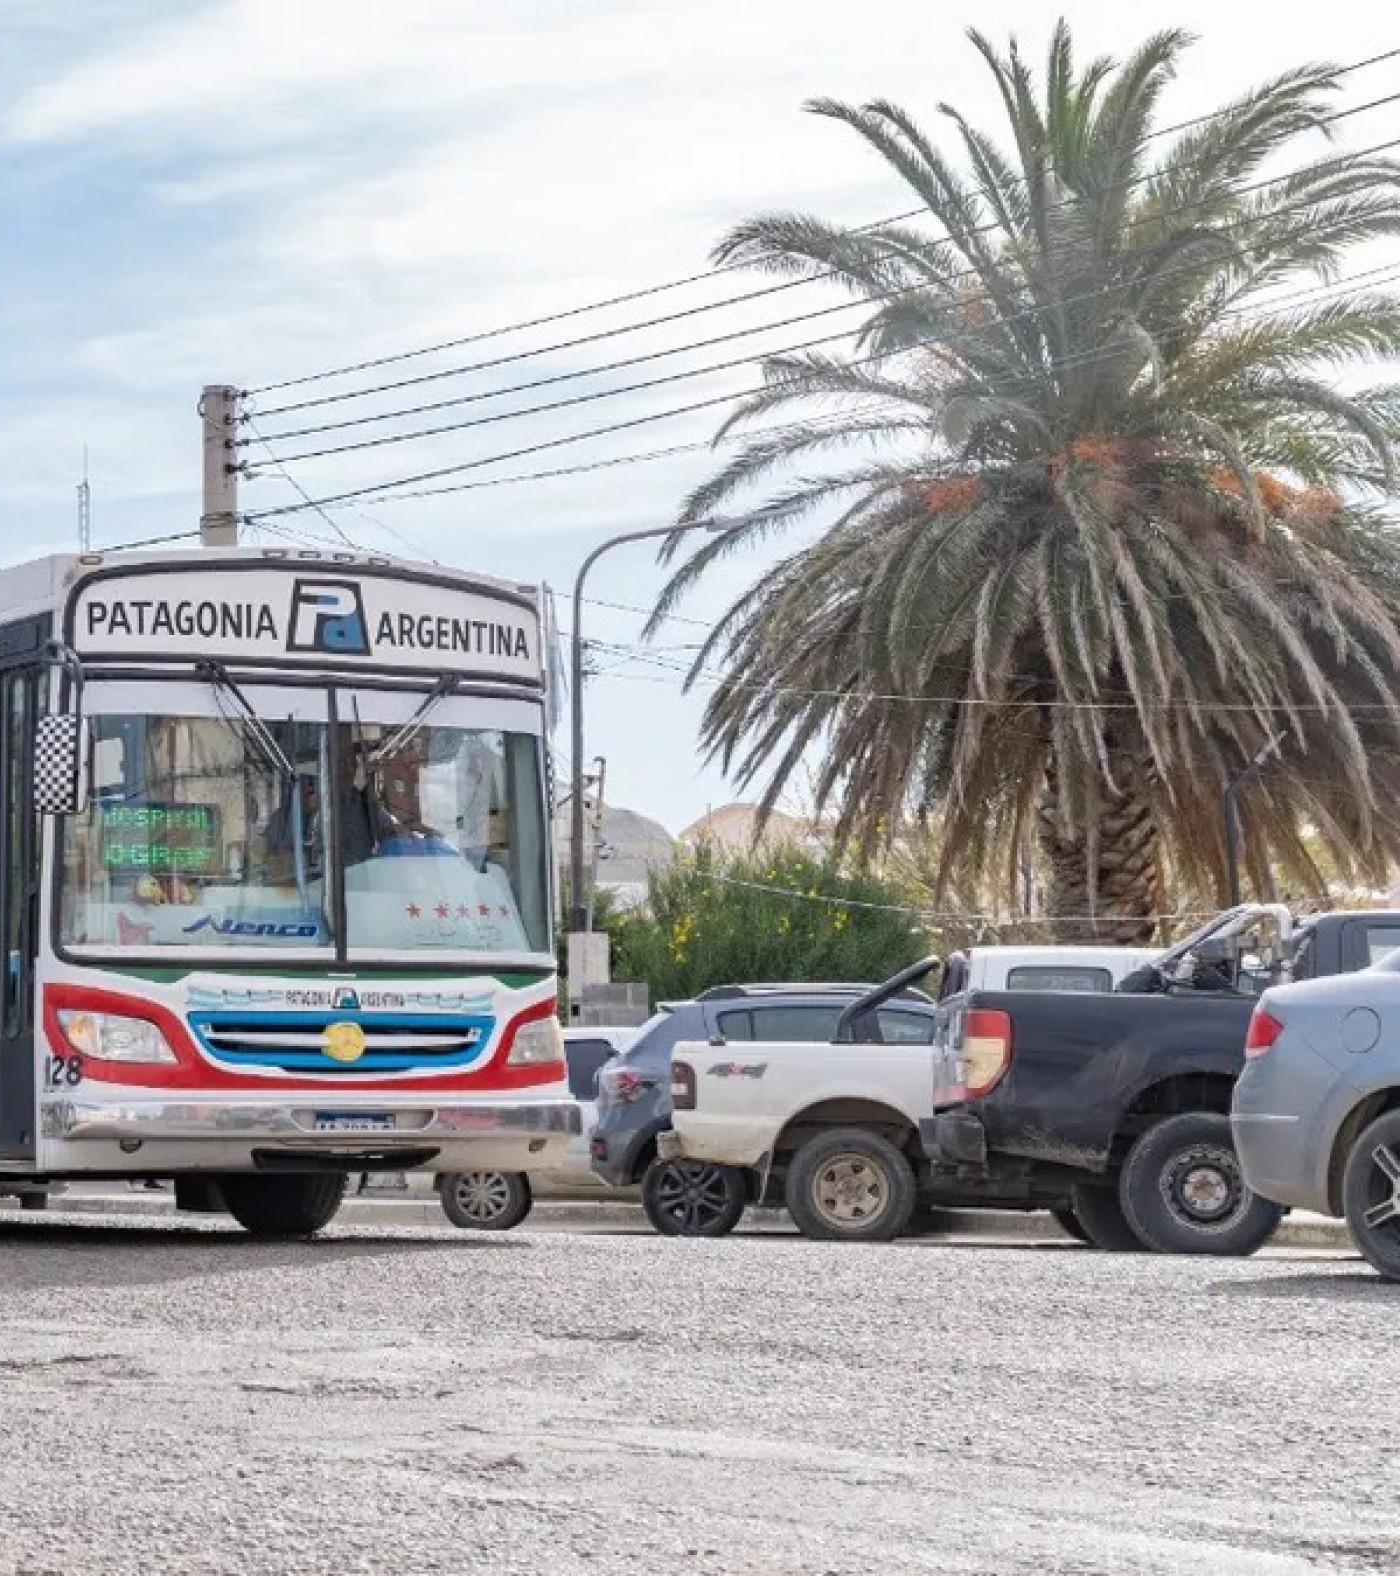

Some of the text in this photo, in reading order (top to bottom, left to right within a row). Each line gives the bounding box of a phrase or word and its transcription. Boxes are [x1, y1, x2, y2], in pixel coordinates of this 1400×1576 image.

[87, 600, 278, 640] PATAGONIA
[375, 611, 530, 659] ARGENTINA
[45, 1055, 83, 1087] 128
